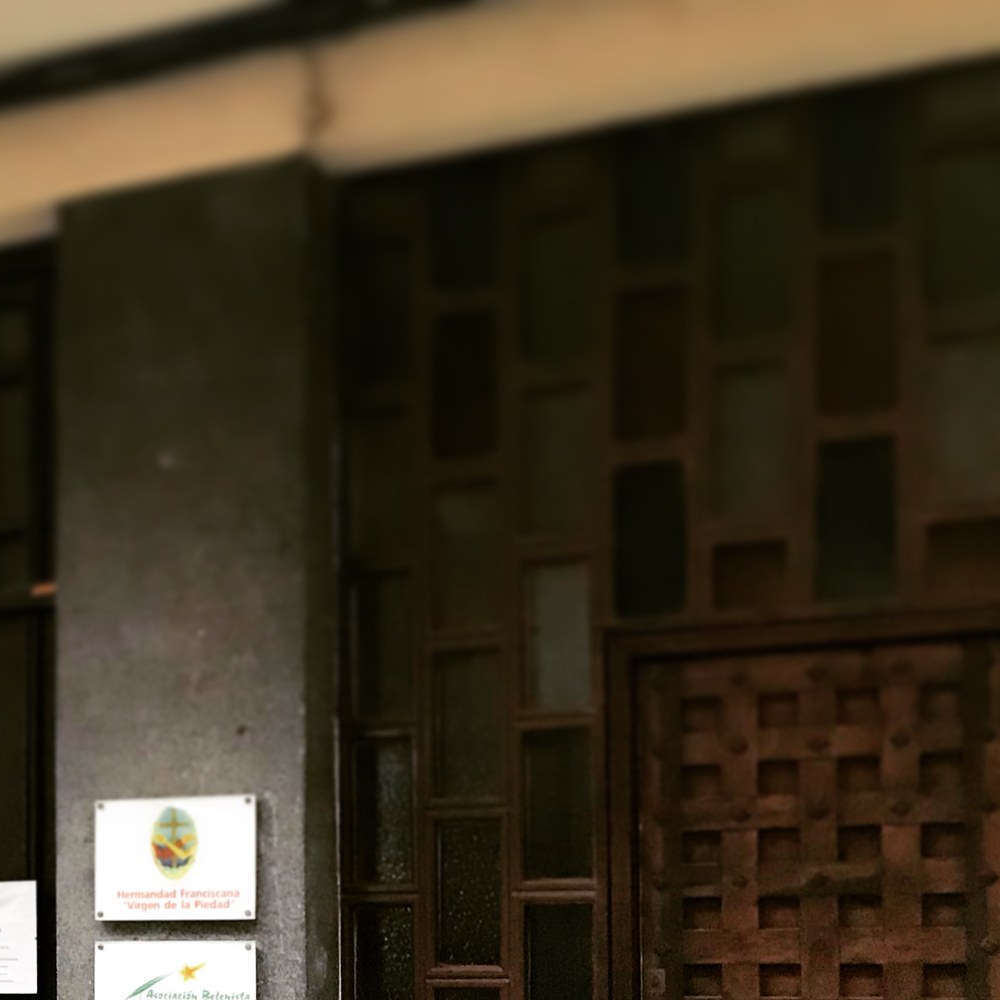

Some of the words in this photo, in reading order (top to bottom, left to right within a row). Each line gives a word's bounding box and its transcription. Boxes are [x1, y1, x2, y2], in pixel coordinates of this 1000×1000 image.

[117, 889, 177, 899] Hermandad
[180, 889, 240, 898] Franciscana
[164, 900, 177, 909] de
[181, 900, 191, 909] la
[146, 989, 198, 1000] Asociación
[202, 990, 250, 1000] Belenista
